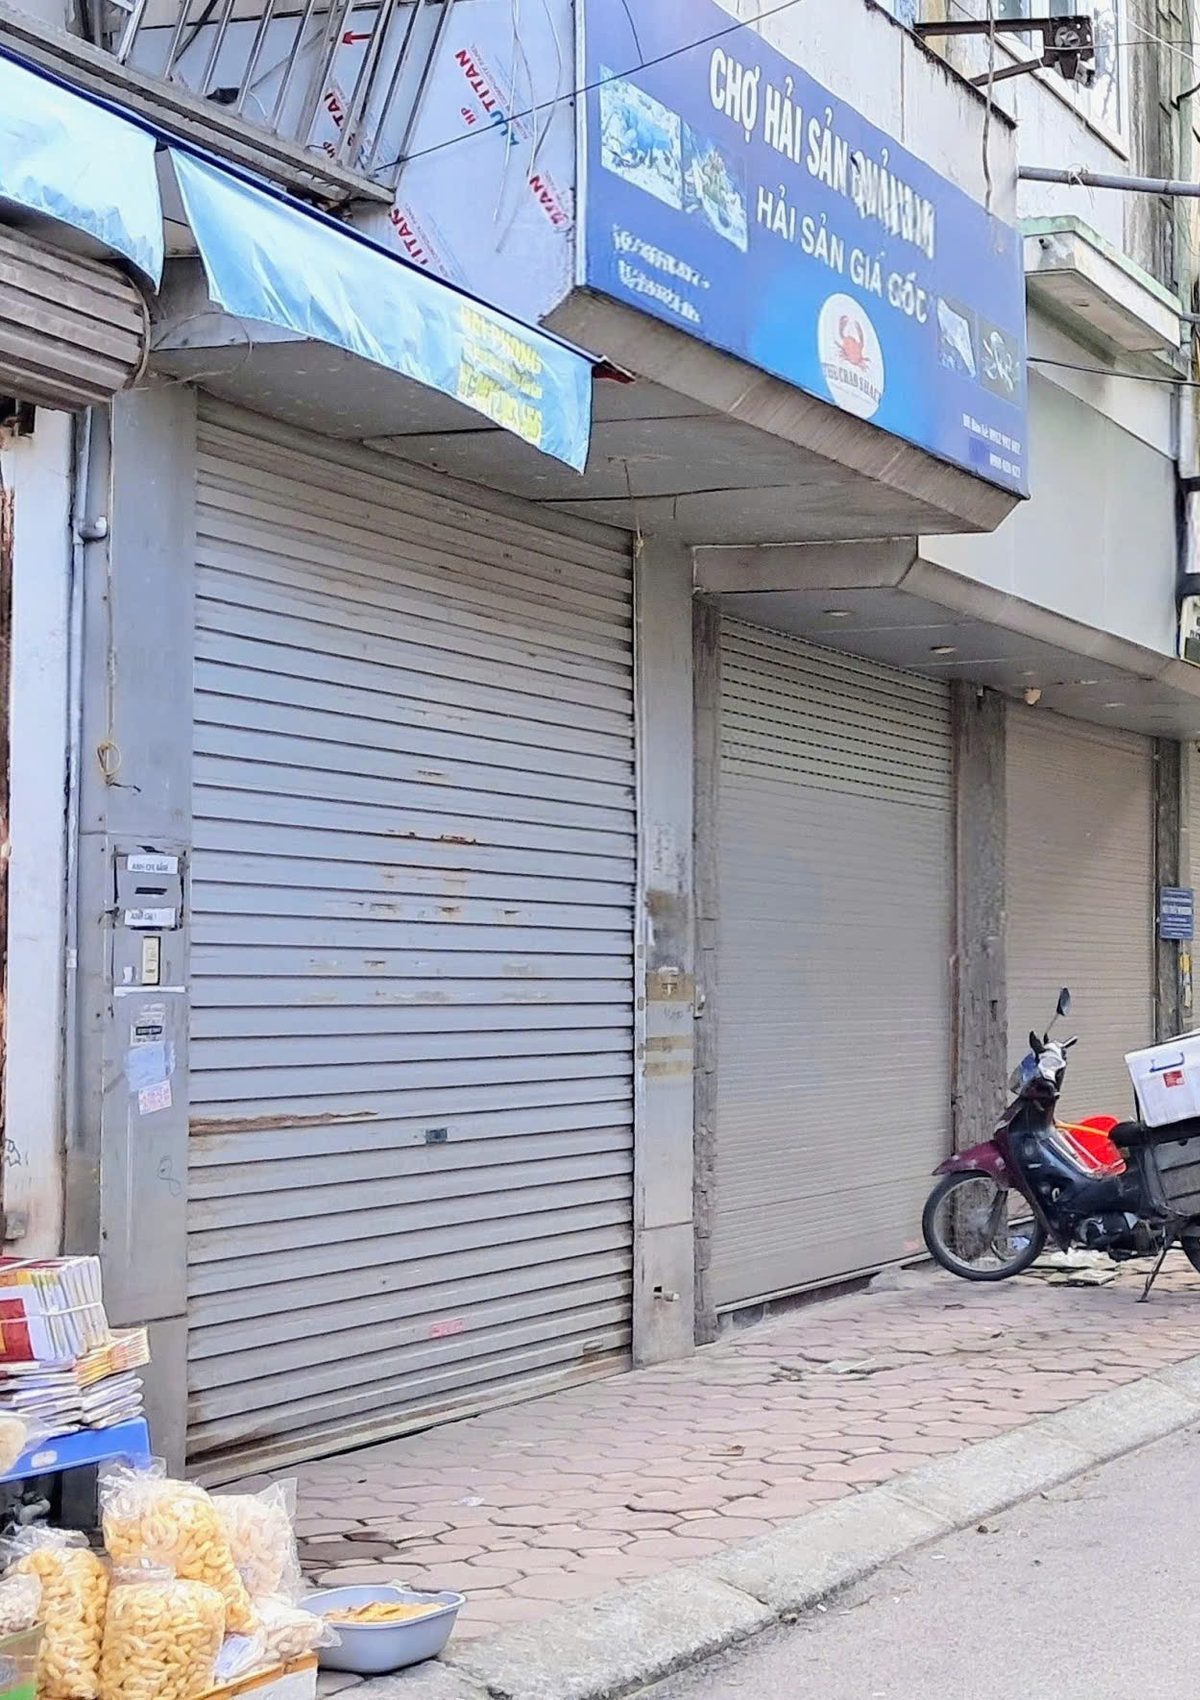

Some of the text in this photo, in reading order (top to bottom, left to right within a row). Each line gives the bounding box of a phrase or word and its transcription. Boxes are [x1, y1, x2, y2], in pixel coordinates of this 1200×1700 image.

[710, 48, 761, 143] CHỢ
[764, 76, 803, 165] HẢI
[807, 107, 848, 196] SẢN
[757, 184, 928, 324] HẢI SẢN GIÁ GỐC
